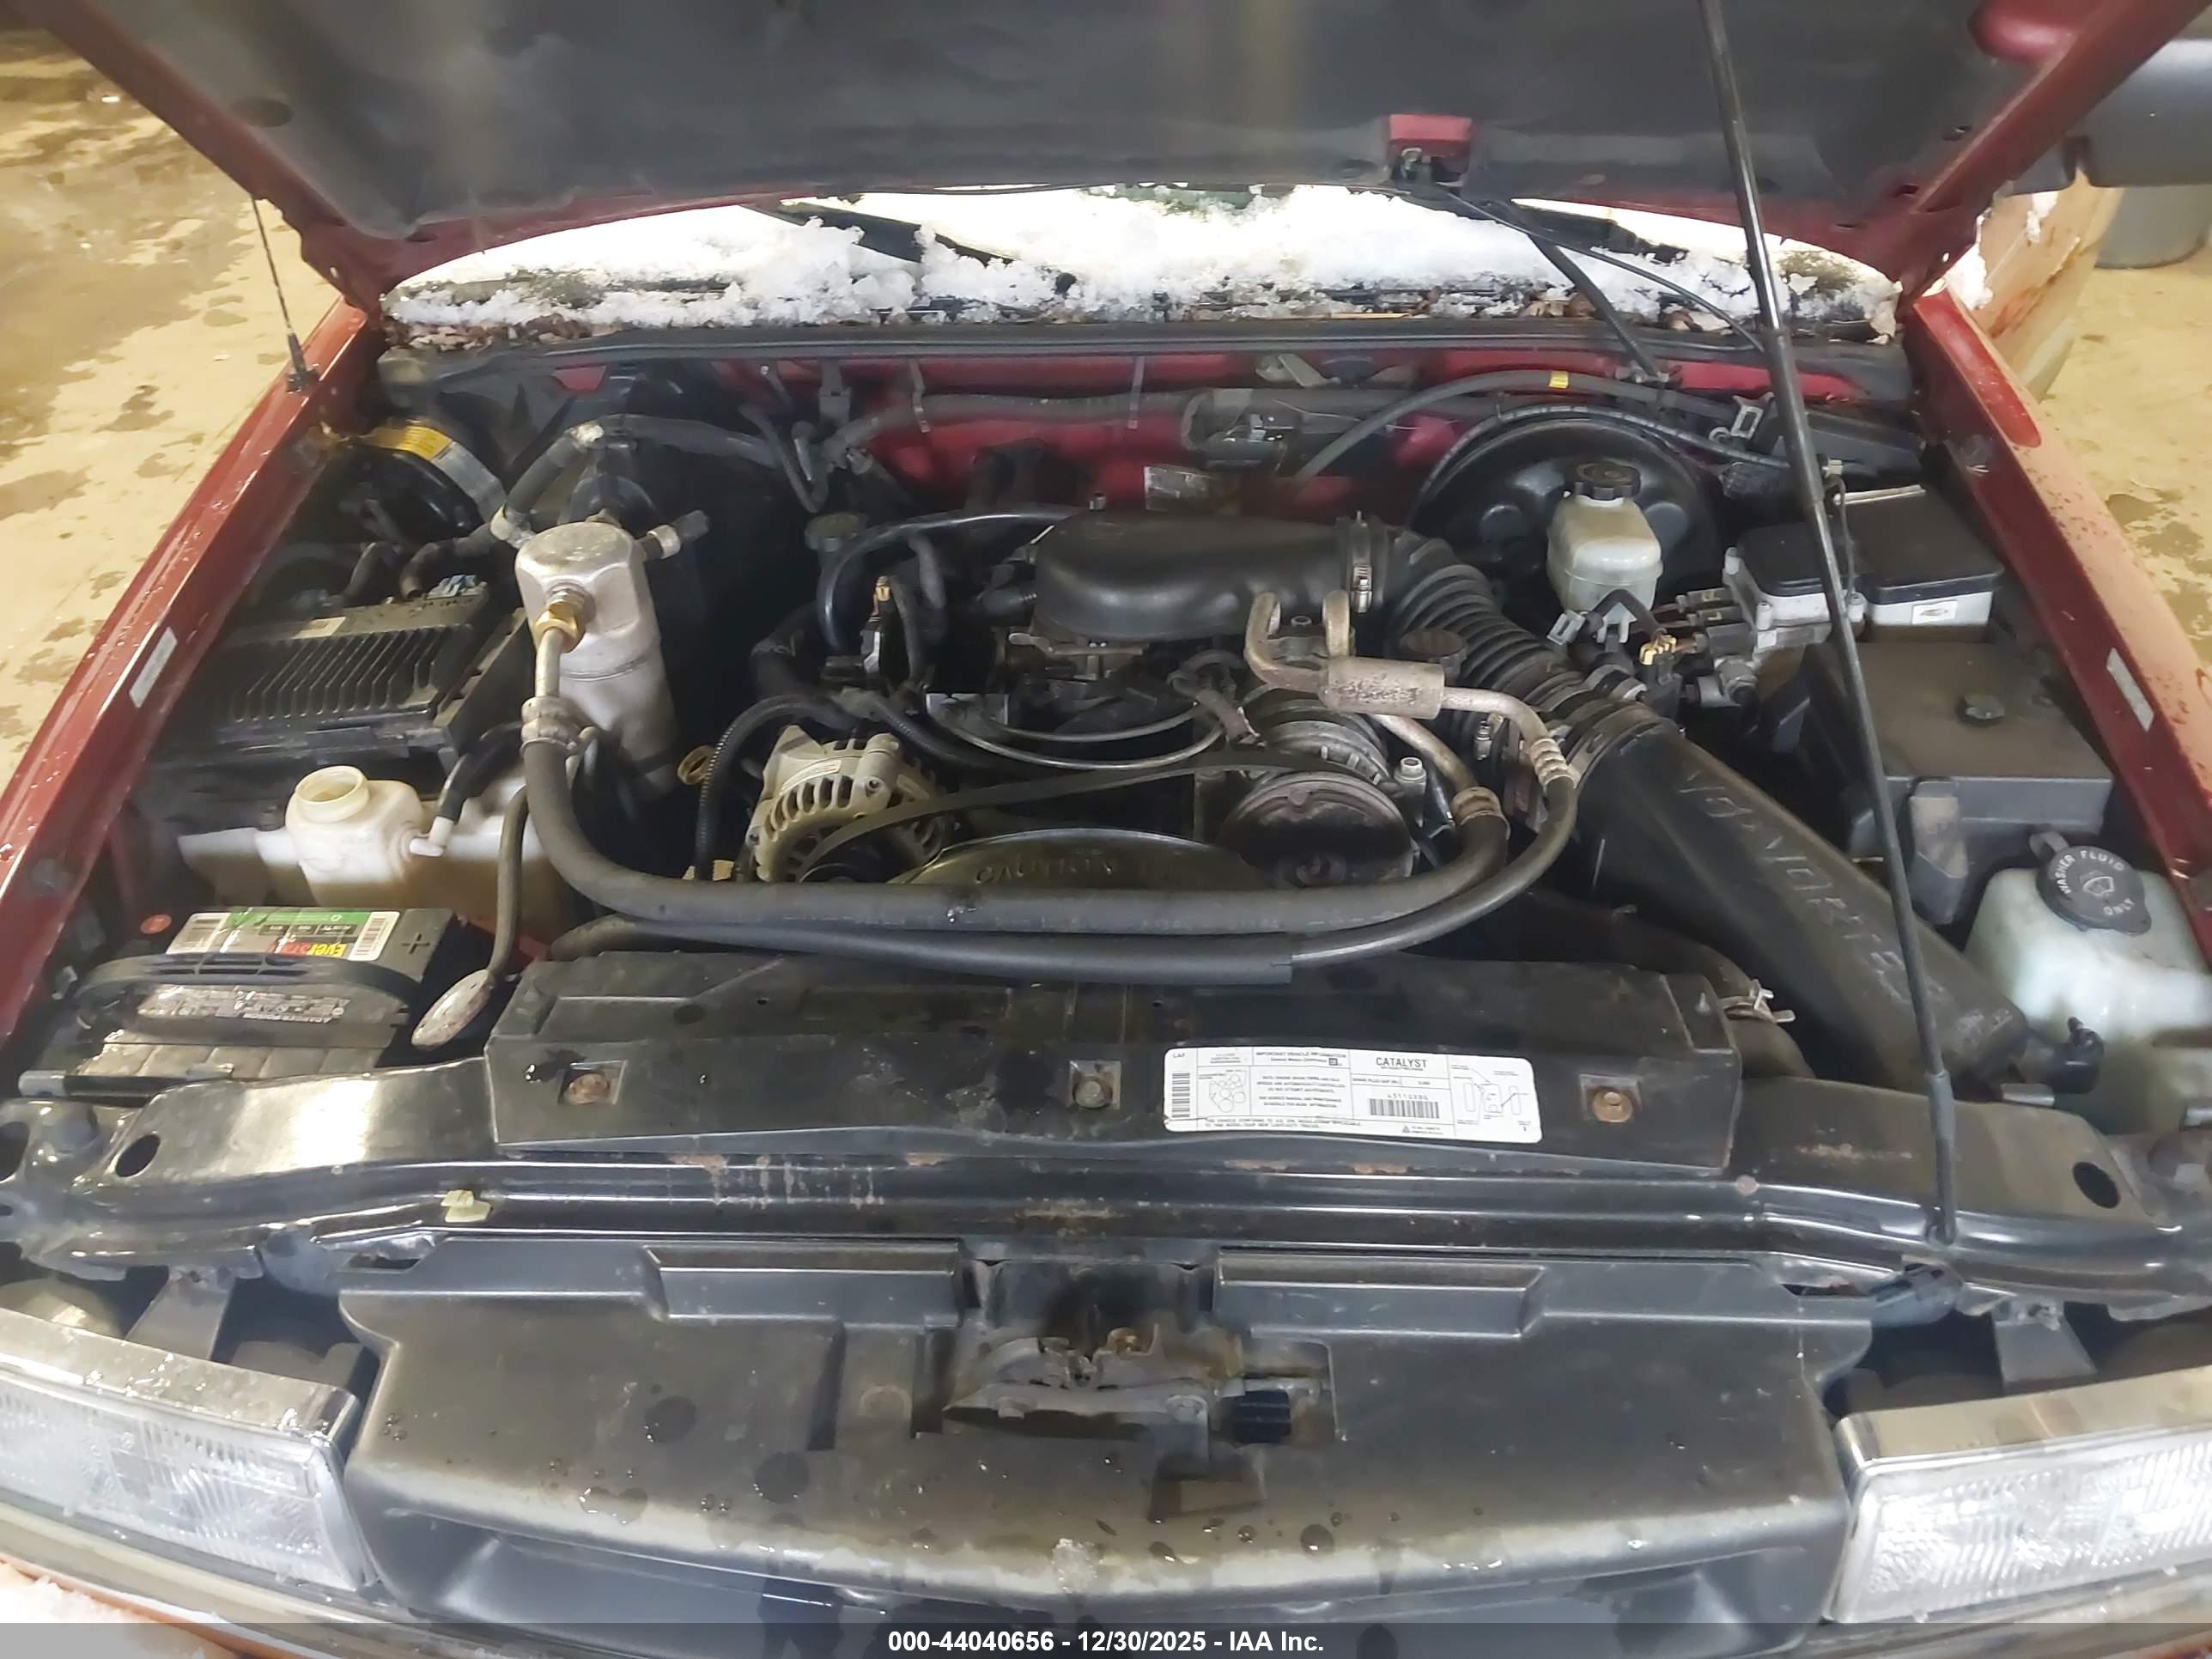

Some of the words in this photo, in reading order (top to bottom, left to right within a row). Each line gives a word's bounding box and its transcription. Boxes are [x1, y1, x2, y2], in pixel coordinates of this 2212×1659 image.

[2056, 854, 2076, 895] WASHER
[2079, 850, 2125, 872] FLUID
[2103, 897, 2136, 916] ONLY
[1376, 1056, 1428, 1068] CATALYST
